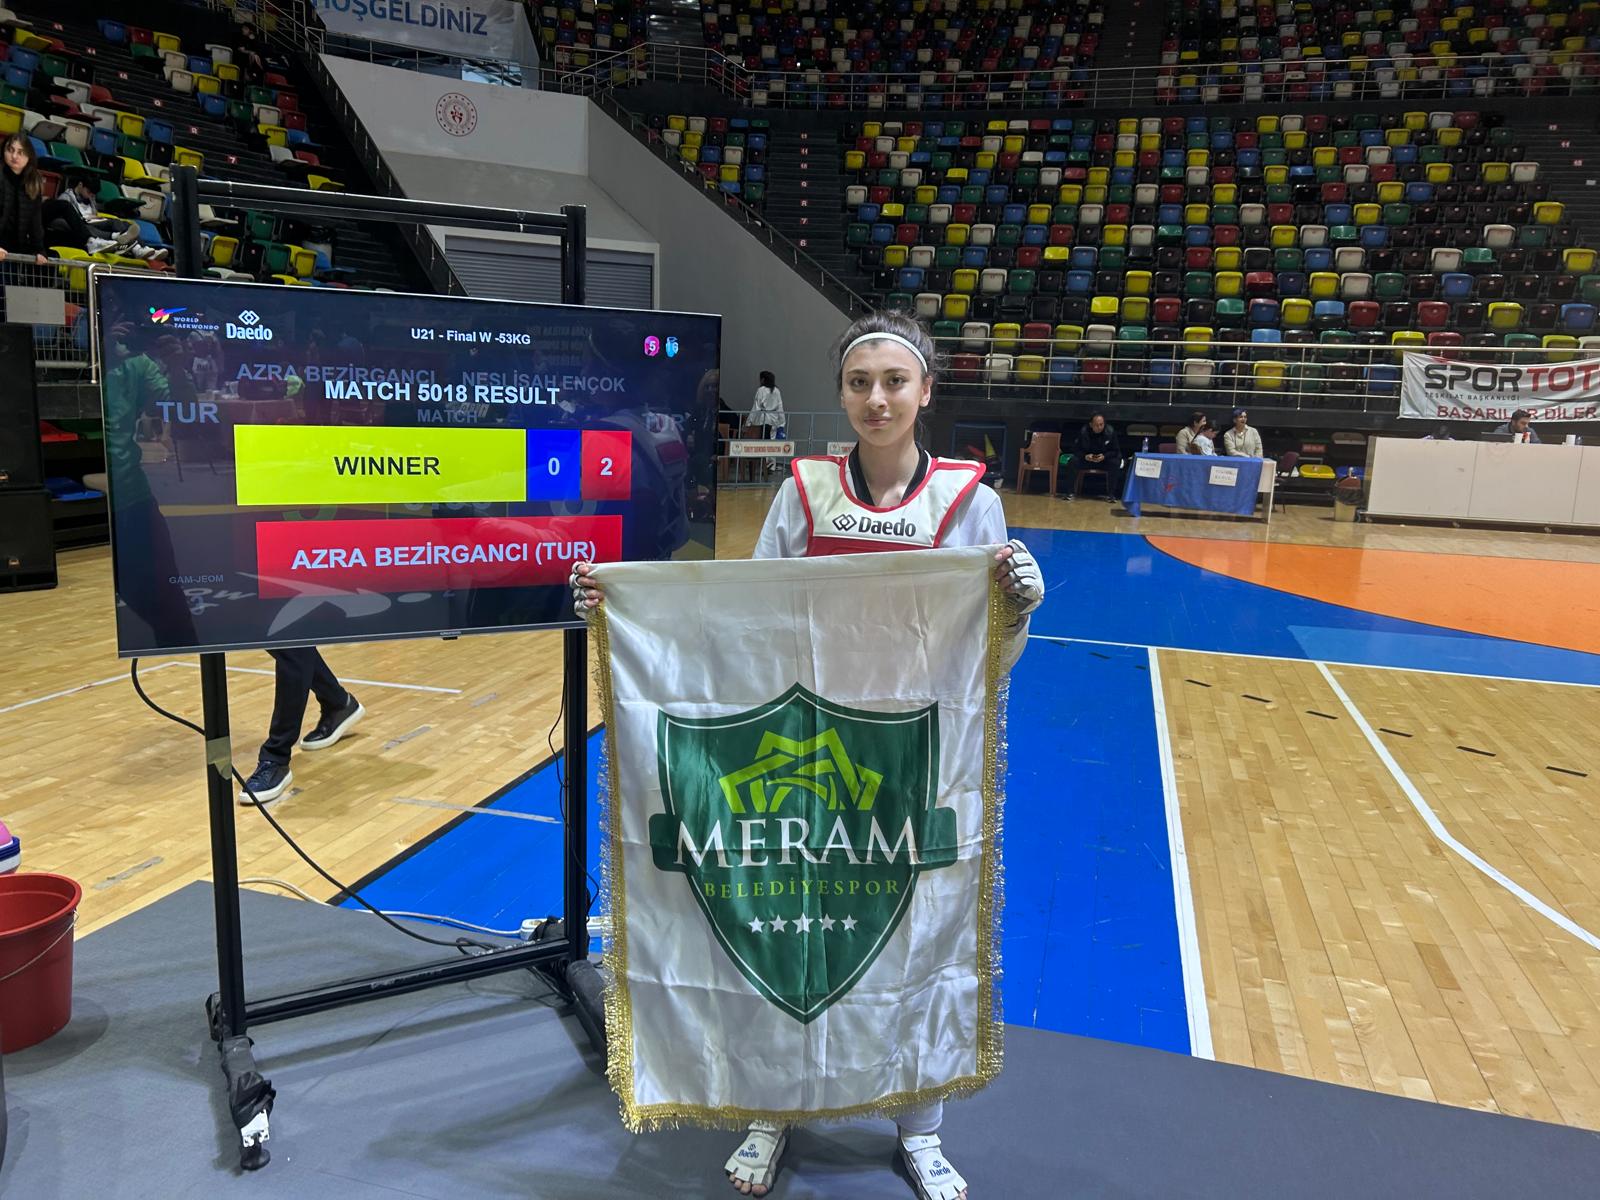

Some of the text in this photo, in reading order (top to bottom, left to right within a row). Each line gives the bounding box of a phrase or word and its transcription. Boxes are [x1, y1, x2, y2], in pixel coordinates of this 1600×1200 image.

[173, 323, 220, 331] TAEKWONDO
[226, 322, 273, 341] Daedo
[411, 328, 435, 340] U21
[446, 330, 477, 342] Final
[479, 331, 492, 343] W
[494, 333, 531, 345] -53KG
[236, 363, 435, 385] AZRA BEZİRGANCI
[1526, 363, 1600, 392] TOT
[325, 380, 560, 405] MATCH 5018 RESULT
[562, 375, 626, 395] ENÇOK
[155, 401, 220, 425] TUR
[417, 409, 479, 424] MATCH
[1437, 405, 1539, 422] BAŞARILR
[334, 456, 441, 476] WINNER
[548, 457, 561, 476] 0
[600, 457, 613, 476] 2
[858, 516, 917, 537] Daedo
[291, 541, 597, 570] AZRA BEZİRGANCI (TUR)
[168, 574, 224, 584] GAM-JEOM
[673, 815, 926, 868] MERAM
[703, 876, 901, 900] BELEDİYESPOR
[928, 1165, 951, 1178] Daedo
